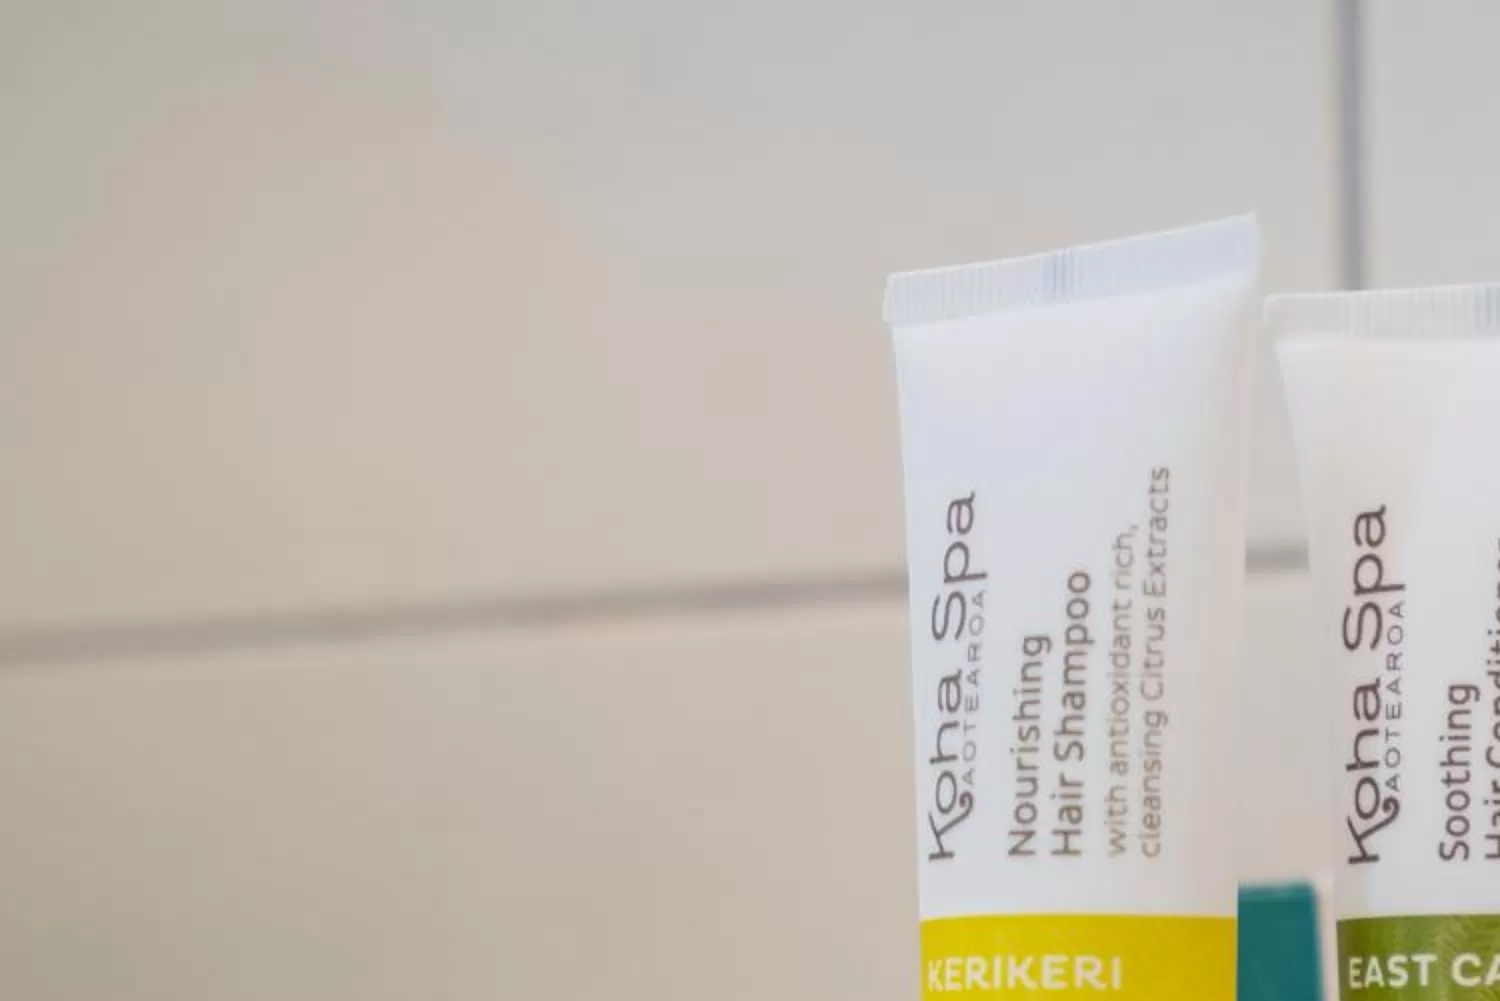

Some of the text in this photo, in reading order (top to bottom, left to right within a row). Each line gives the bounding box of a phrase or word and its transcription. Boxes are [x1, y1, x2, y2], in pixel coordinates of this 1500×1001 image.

[928, 491, 988, 862] Koha Spa
[962, 589, 987, 786] AOTEAROA
[1008, 633, 1052, 857] Nourishing
[1050, 570, 1096, 857] Hair Shampoo
[1104, 524, 1139, 859] with antioxidant rich,
[1140, 465, 1170, 859] cleansing Citrus Extracts
[1342, 503, 1406, 866] Koha Spa
[1384, 600, 1405, 792] AOTEAROA
[1439, 683, 1480, 862] Soothing
[927, 954, 1122, 992] KERIKERI
[1349, 954, 1438, 990] EAST
